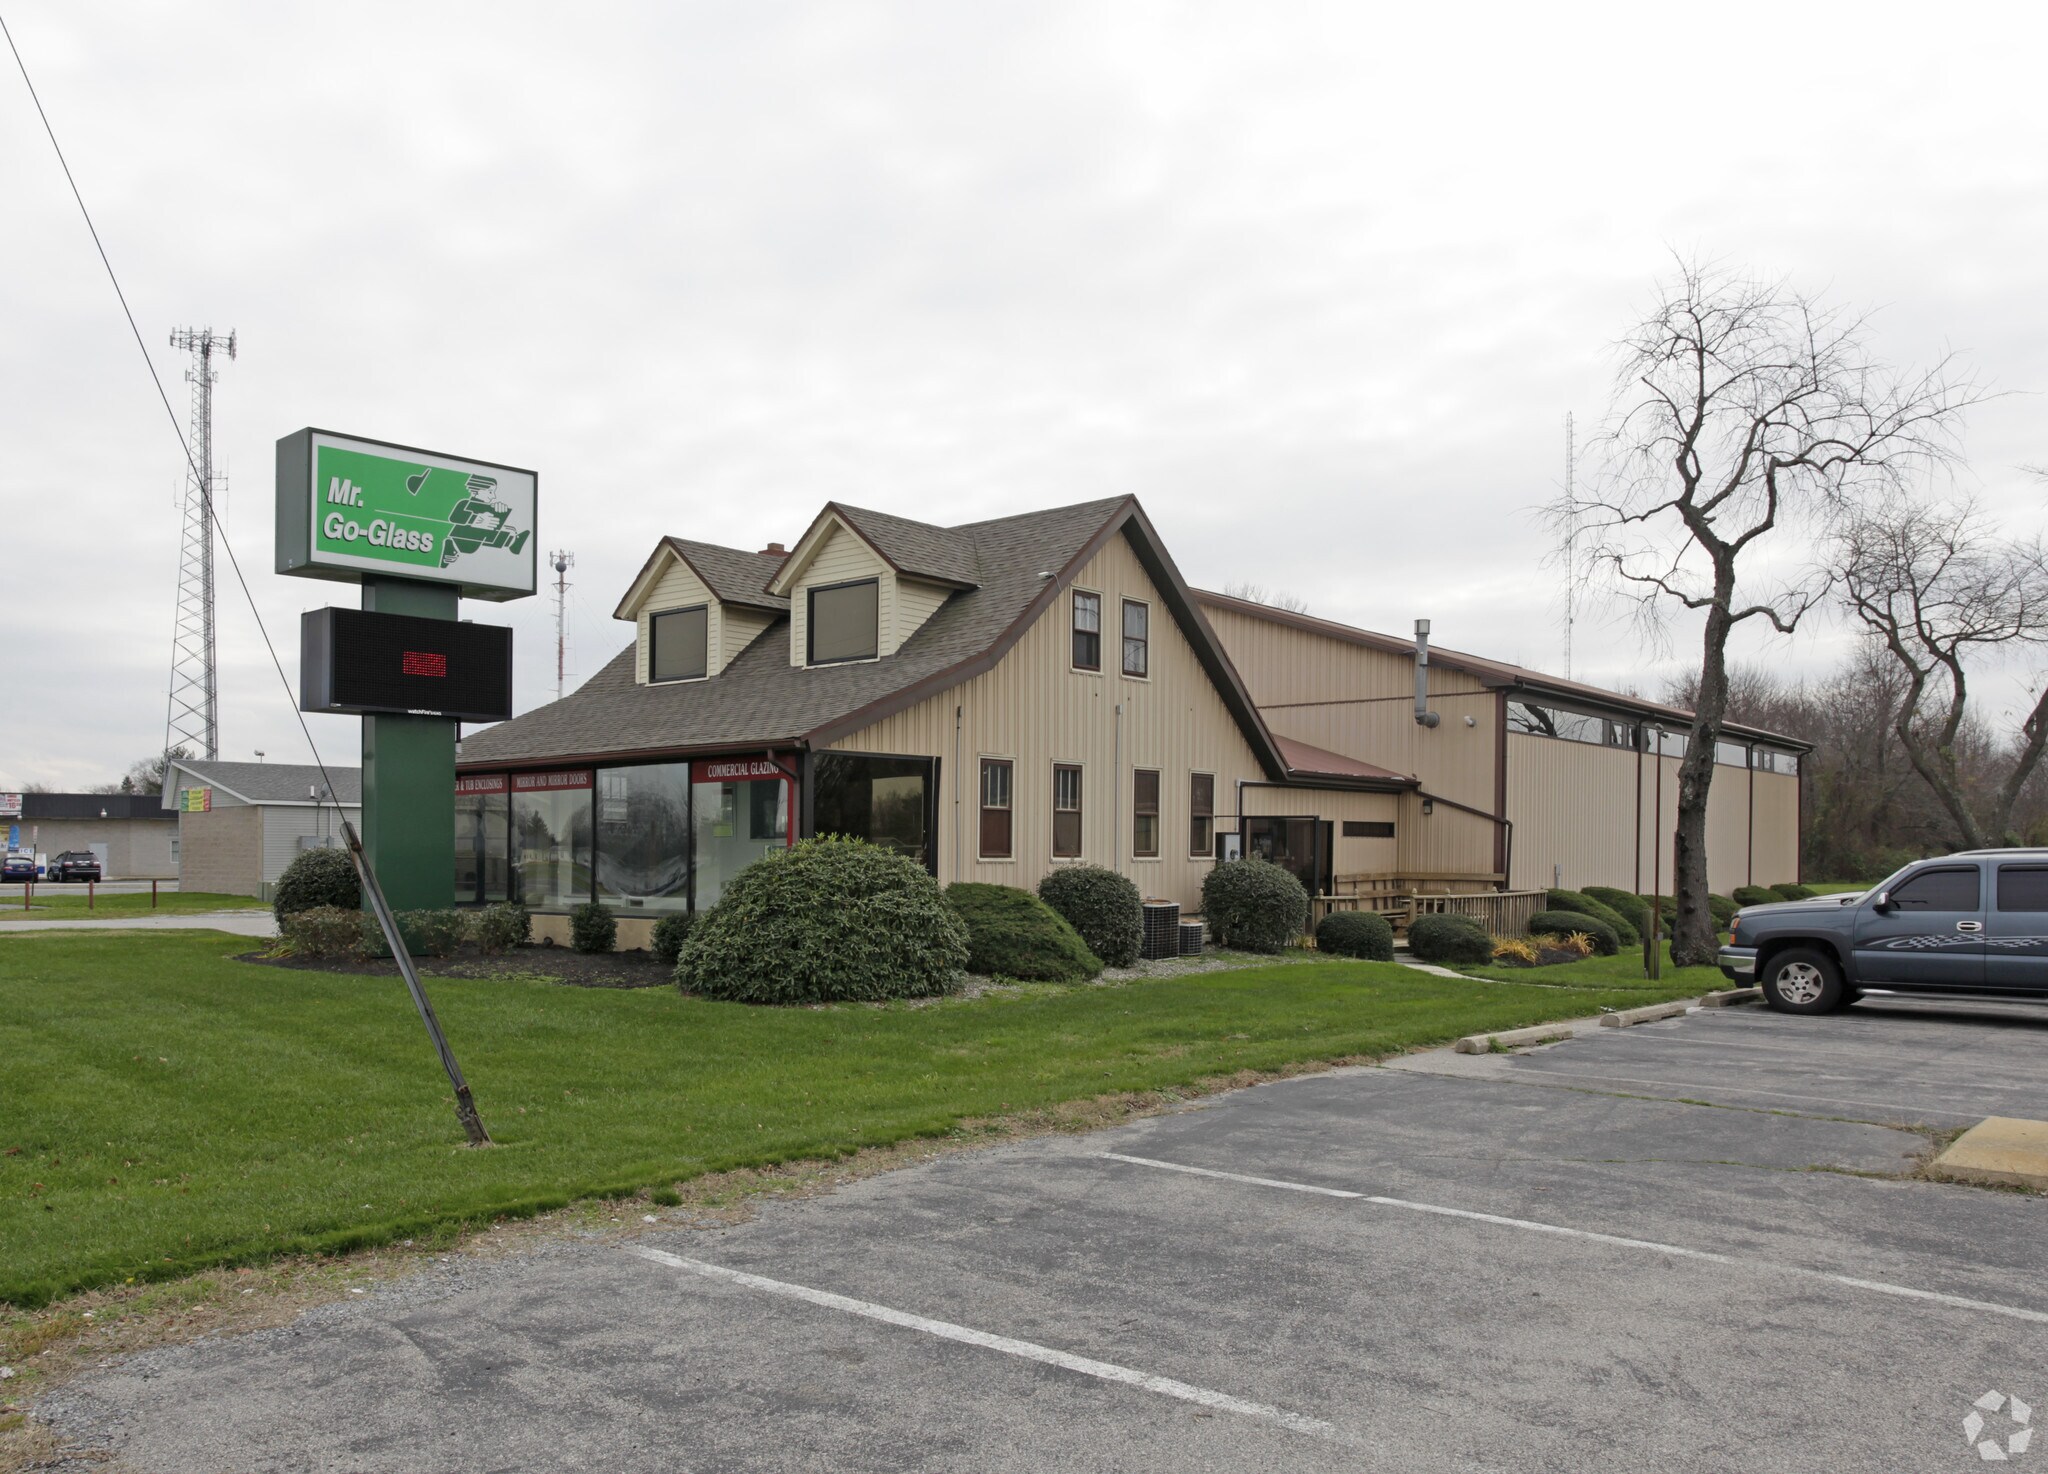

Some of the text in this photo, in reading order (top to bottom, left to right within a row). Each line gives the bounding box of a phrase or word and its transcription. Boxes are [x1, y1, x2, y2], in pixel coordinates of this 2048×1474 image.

[327, 477, 364, 508] Mr.
[323, 511, 434, 554] Go-Glass
[536, 776, 547, 787] AND
[569, 773, 588, 785] DOORS
[708, 761, 779, 777] COMMERCIAL GLAZING
